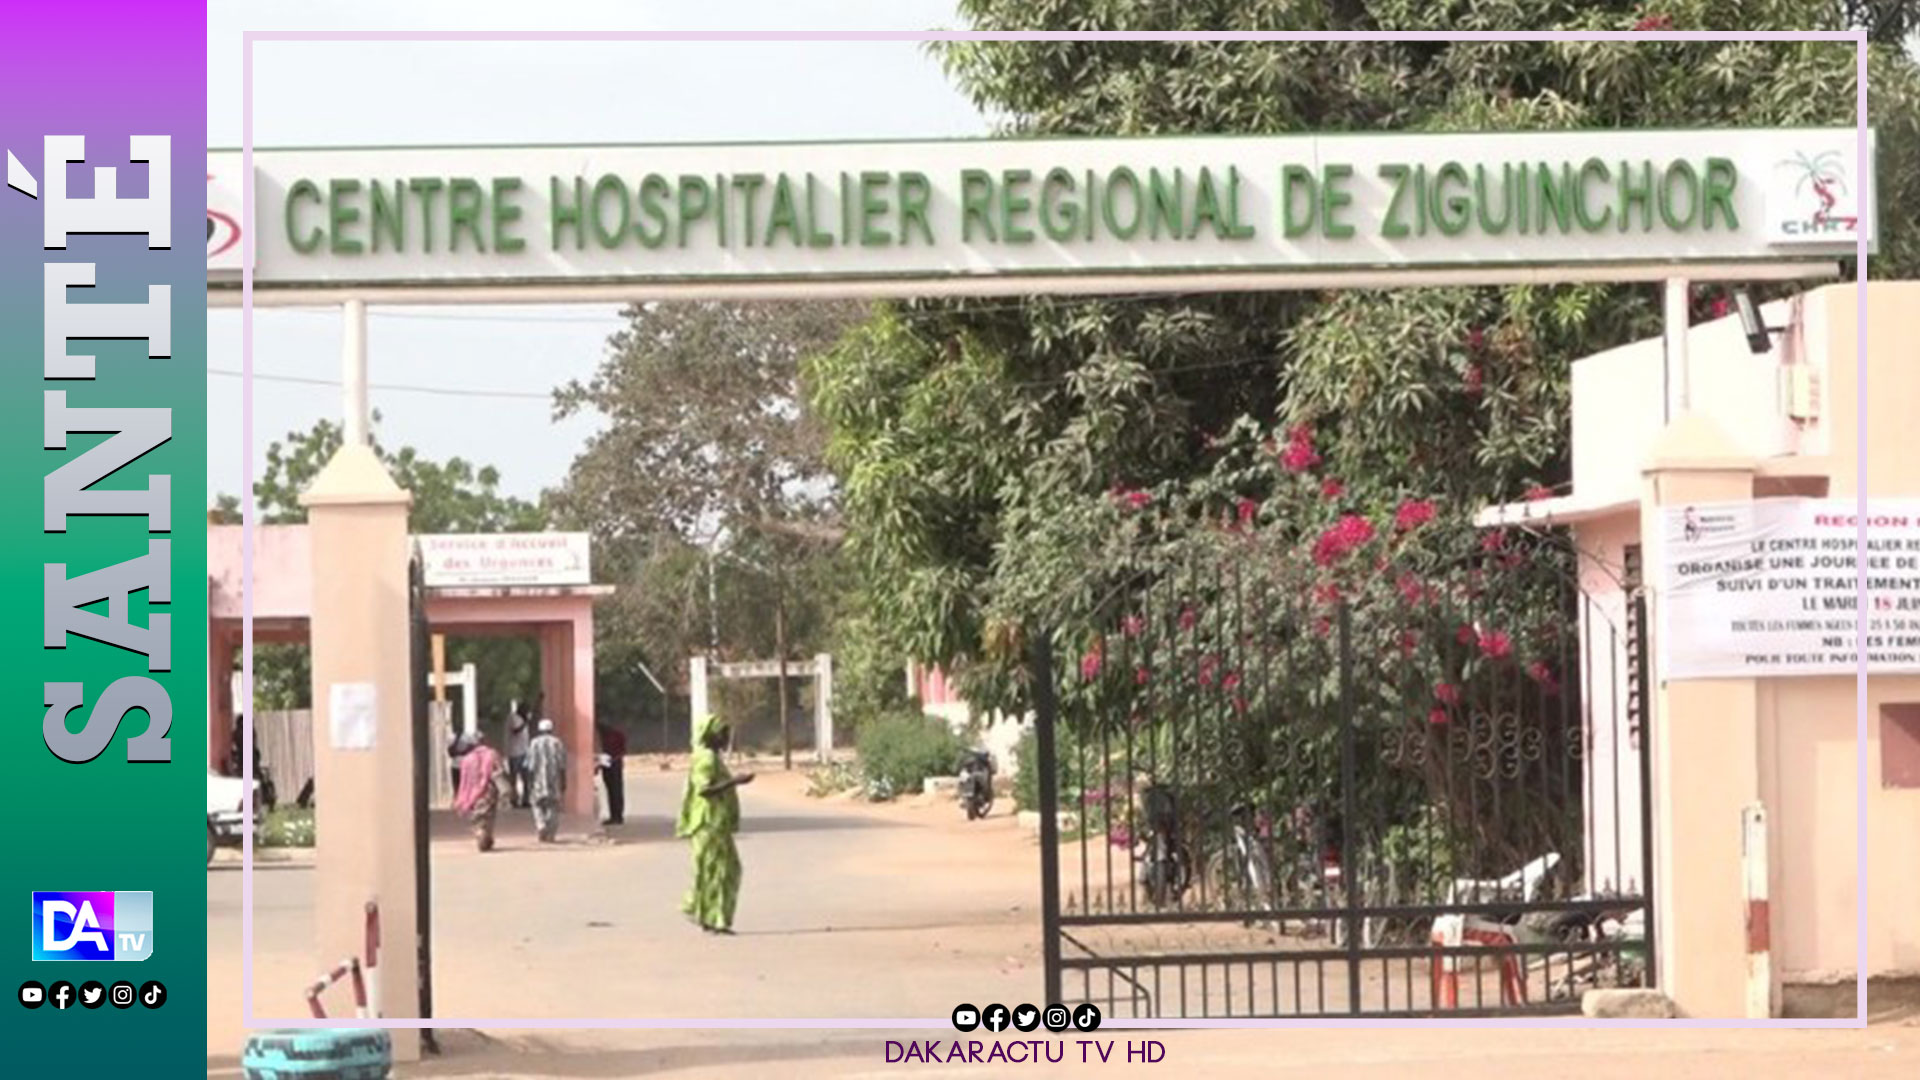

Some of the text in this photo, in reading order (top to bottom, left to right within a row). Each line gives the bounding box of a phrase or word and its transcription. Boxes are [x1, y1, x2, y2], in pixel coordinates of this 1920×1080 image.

[284, 156, 1740, 255] CENTRE HOSPITALIER REGIONAL DE ZIGUINCHOR
[1751, 540, 1766, 553] LE
[1769, 538, 1817, 551] CENTRE
[1677, 558, 1766, 576] ORGANISE
[1769, 557, 1804, 570] UNE
[1896, 557, 1918, 570] DE
[1717, 578, 1762, 591] SUIVI
[1768, 578, 1808, 590] D'UN
[1802, 597, 1817, 610] LE
